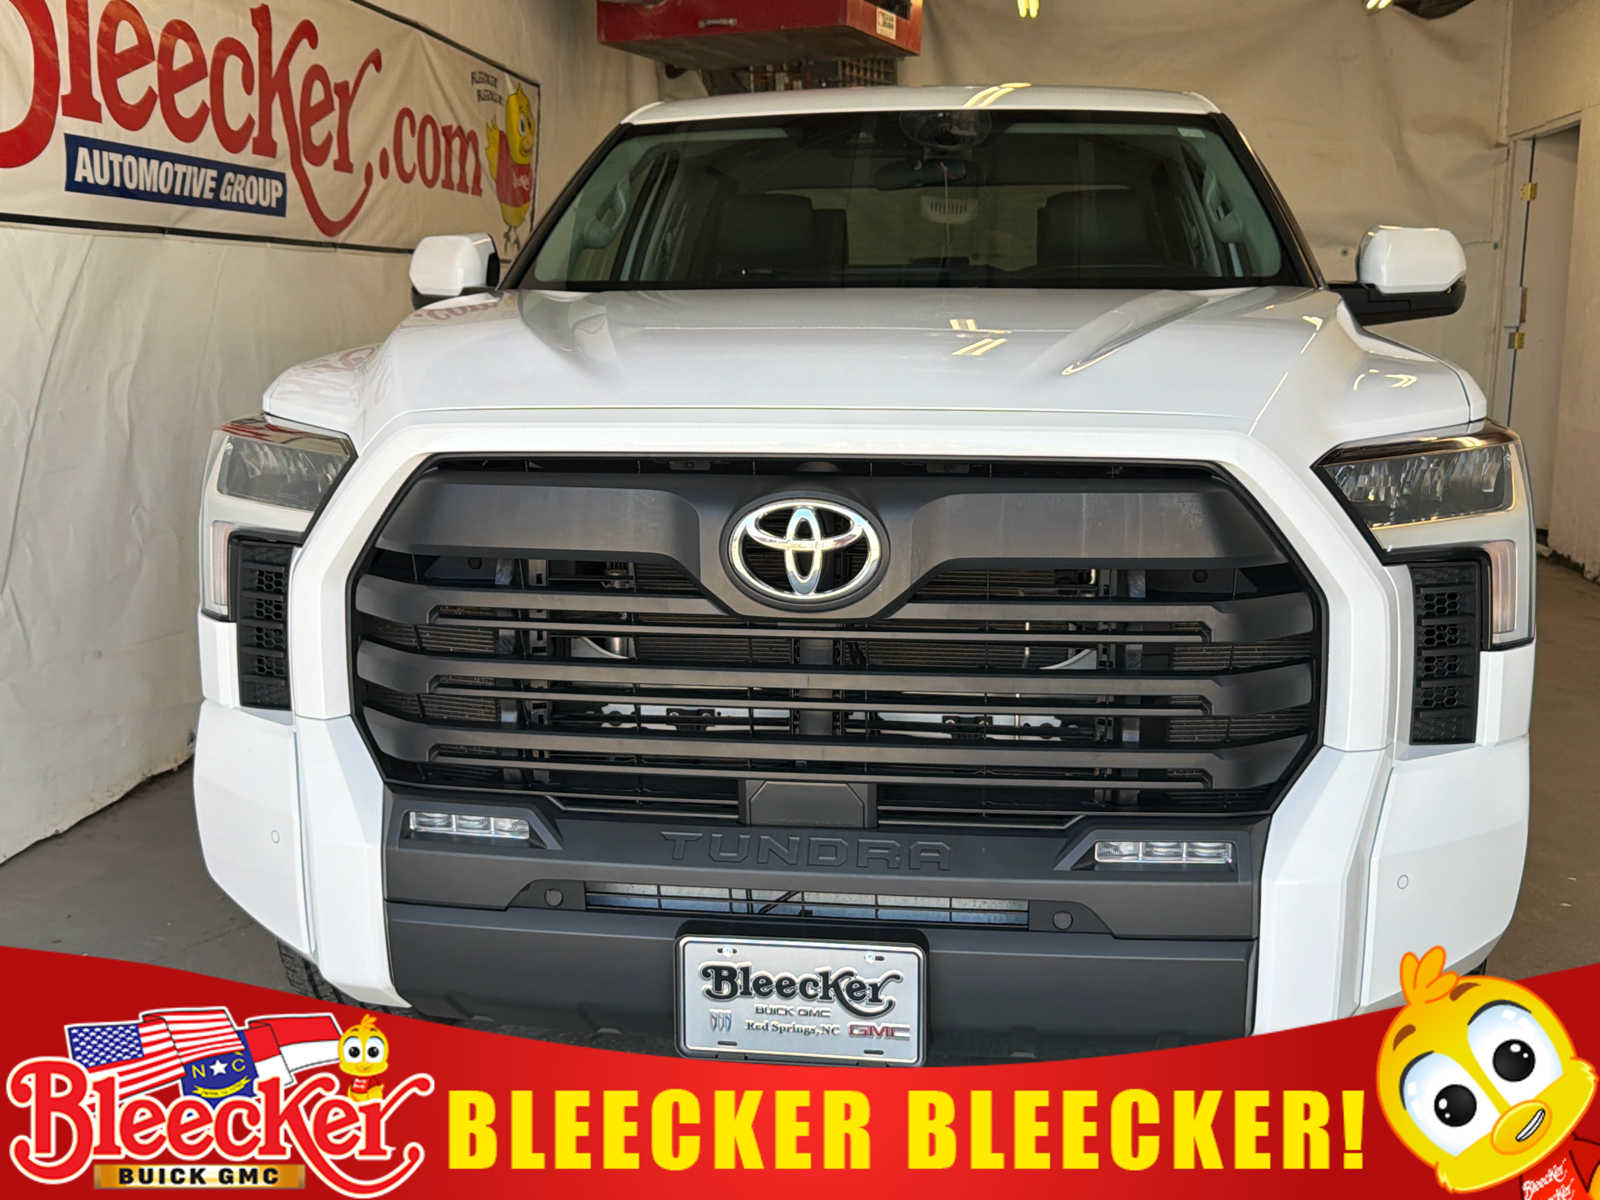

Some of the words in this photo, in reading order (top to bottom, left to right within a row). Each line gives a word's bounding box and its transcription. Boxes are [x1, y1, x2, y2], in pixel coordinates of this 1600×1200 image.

[74, 146, 217, 200] AUTOMOTIVE
[219, 171, 284, 208] GROUP
[661, 831, 951, 870] TUNDRA
[700, 961, 904, 1018] Bleecker
[755, 1004, 795, 1017] BUICK
[798, 1007, 831, 1018] GMC
[746, 1021, 770, 1032] Red
[771, 1023, 819, 1037] Springs,
[819, 1025, 840, 1036] NC
[849, 1022, 911, 1041] GMC
